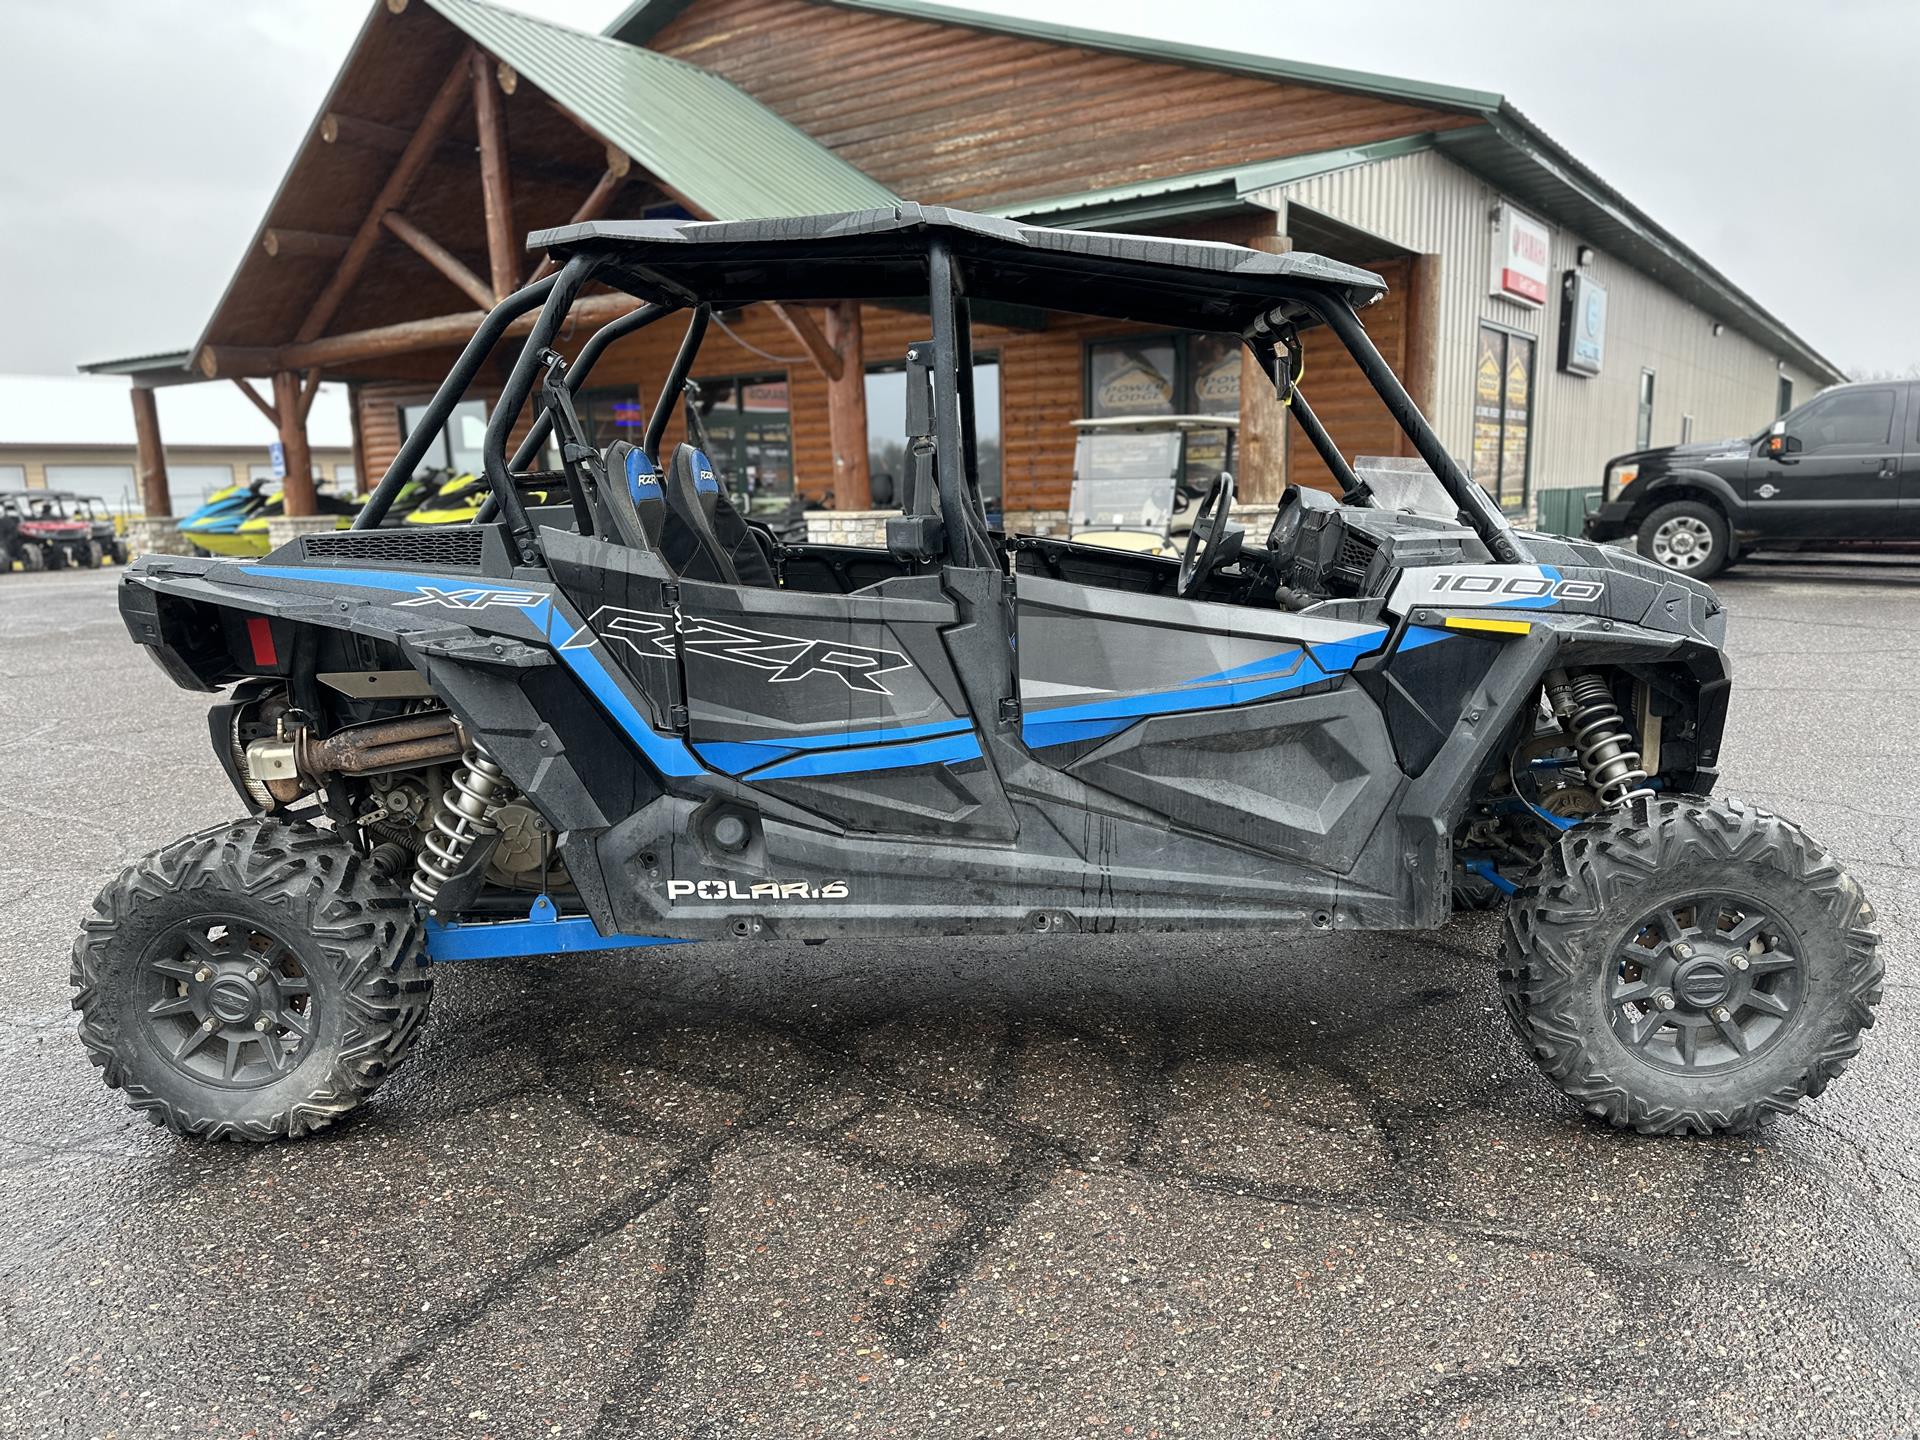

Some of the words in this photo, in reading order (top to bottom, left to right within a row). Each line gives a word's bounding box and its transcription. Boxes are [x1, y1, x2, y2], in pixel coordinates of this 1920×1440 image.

[638, 474, 658, 487] RZR
[700, 470, 715, 480] RZR
[391, 586, 550, 610] XP
[1428, 572, 1604, 602] 1000
[558, 605, 914, 696] RZR
